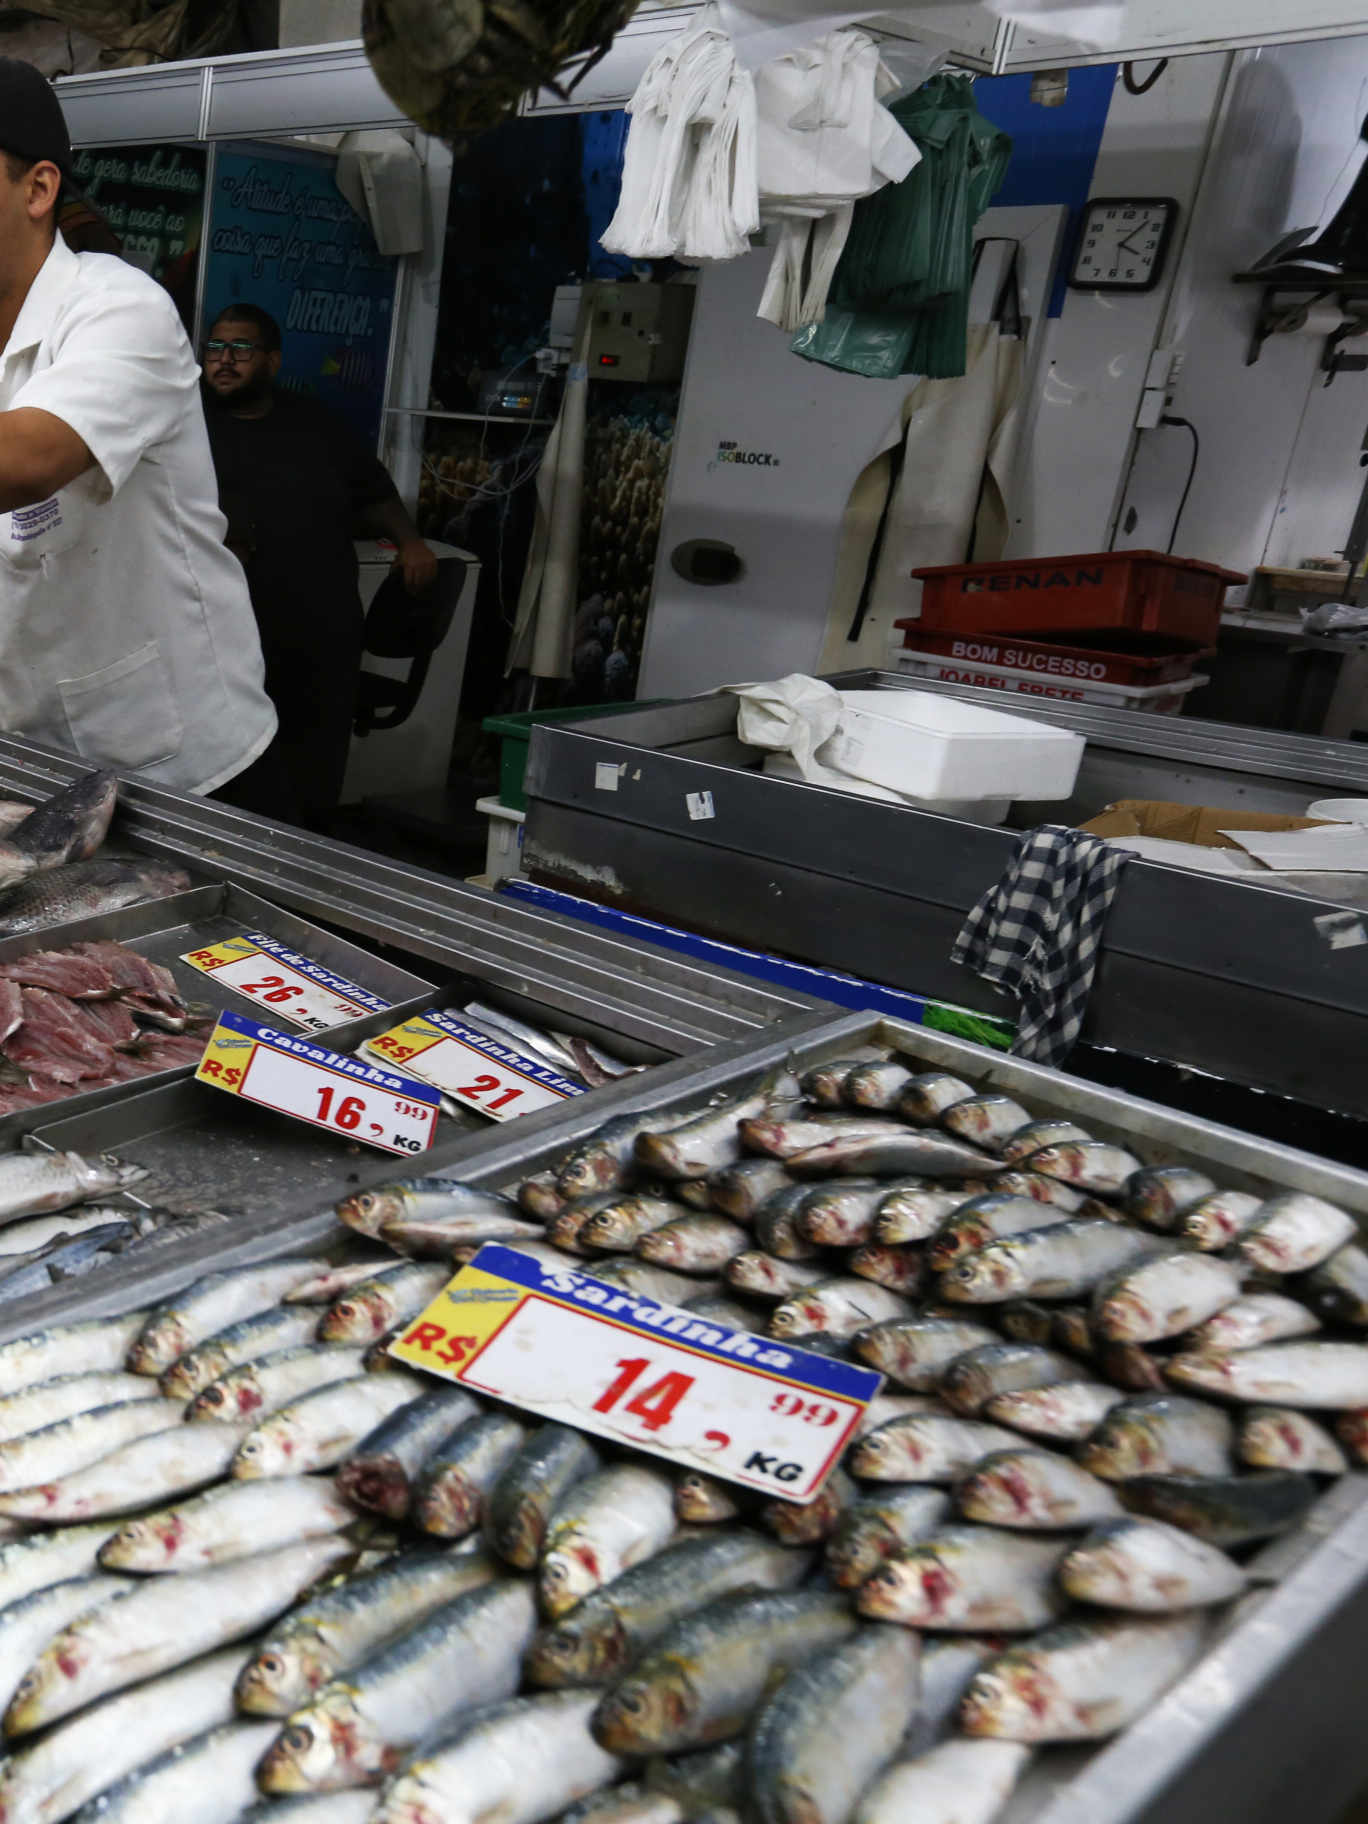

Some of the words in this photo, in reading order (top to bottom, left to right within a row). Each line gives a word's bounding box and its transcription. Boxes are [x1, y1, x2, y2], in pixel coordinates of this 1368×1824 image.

[1091, 224, 1104, 232] 10
[1151, 223, 1161, 232] 2
[1123, 211, 1137, 220] 12
[1093, 268, 1101, 277] 7
[717, 449, 773, 467] ISOBLOCK
[960, 568, 1104, 594] RENAN
[952, 641, 999, 664] BOM
[1003, 649, 1107, 681] SUCESSO
[249, 933, 289, 955] Filé
[280, 951, 304, 966] de
[301, 963, 392, 1012] Sardinha
[189, 950, 226, 968] R$
[303, 1017, 330, 1030] KG
[373, 1036, 415, 1059] R$
[425, 1012, 535, 1072] Sardinha
[201, 1059, 242, 1086] R$
[257, 1028, 403, 1090] Cavalinha
[394, 1101, 428, 1121] 99
[393, 1134, 422, 1152] KG
[541, 1268, 793, 1371] Sardinha
[403, 1322, 481, 1367] R$
[769, 1392, 840, 1429] 99
[743, 1451, 805, 1484] KG
